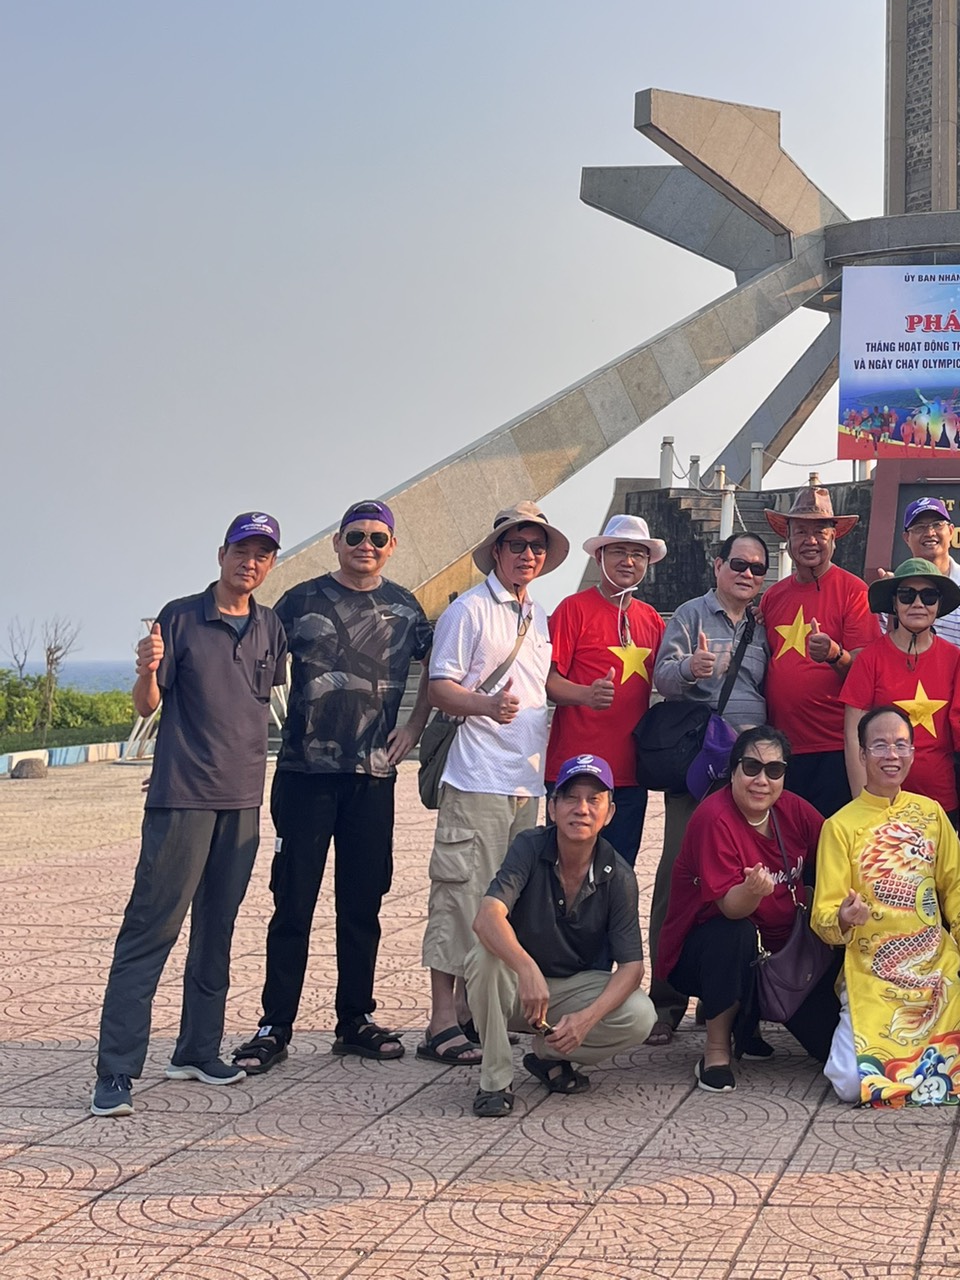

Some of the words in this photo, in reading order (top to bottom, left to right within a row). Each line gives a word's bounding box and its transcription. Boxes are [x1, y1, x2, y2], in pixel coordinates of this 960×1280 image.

[918, 274, 936, 282] BAN
[865, 339, 896, 353] THÁNG
[898, 341, 922, 354] HOẠT
[924, 339, 950, 353] ĐỘNG
[854, 357, 866, 370] VÀ
[868, 357, 892, 370] NGÀY
[896, 359, 920, 371] CHẠY
